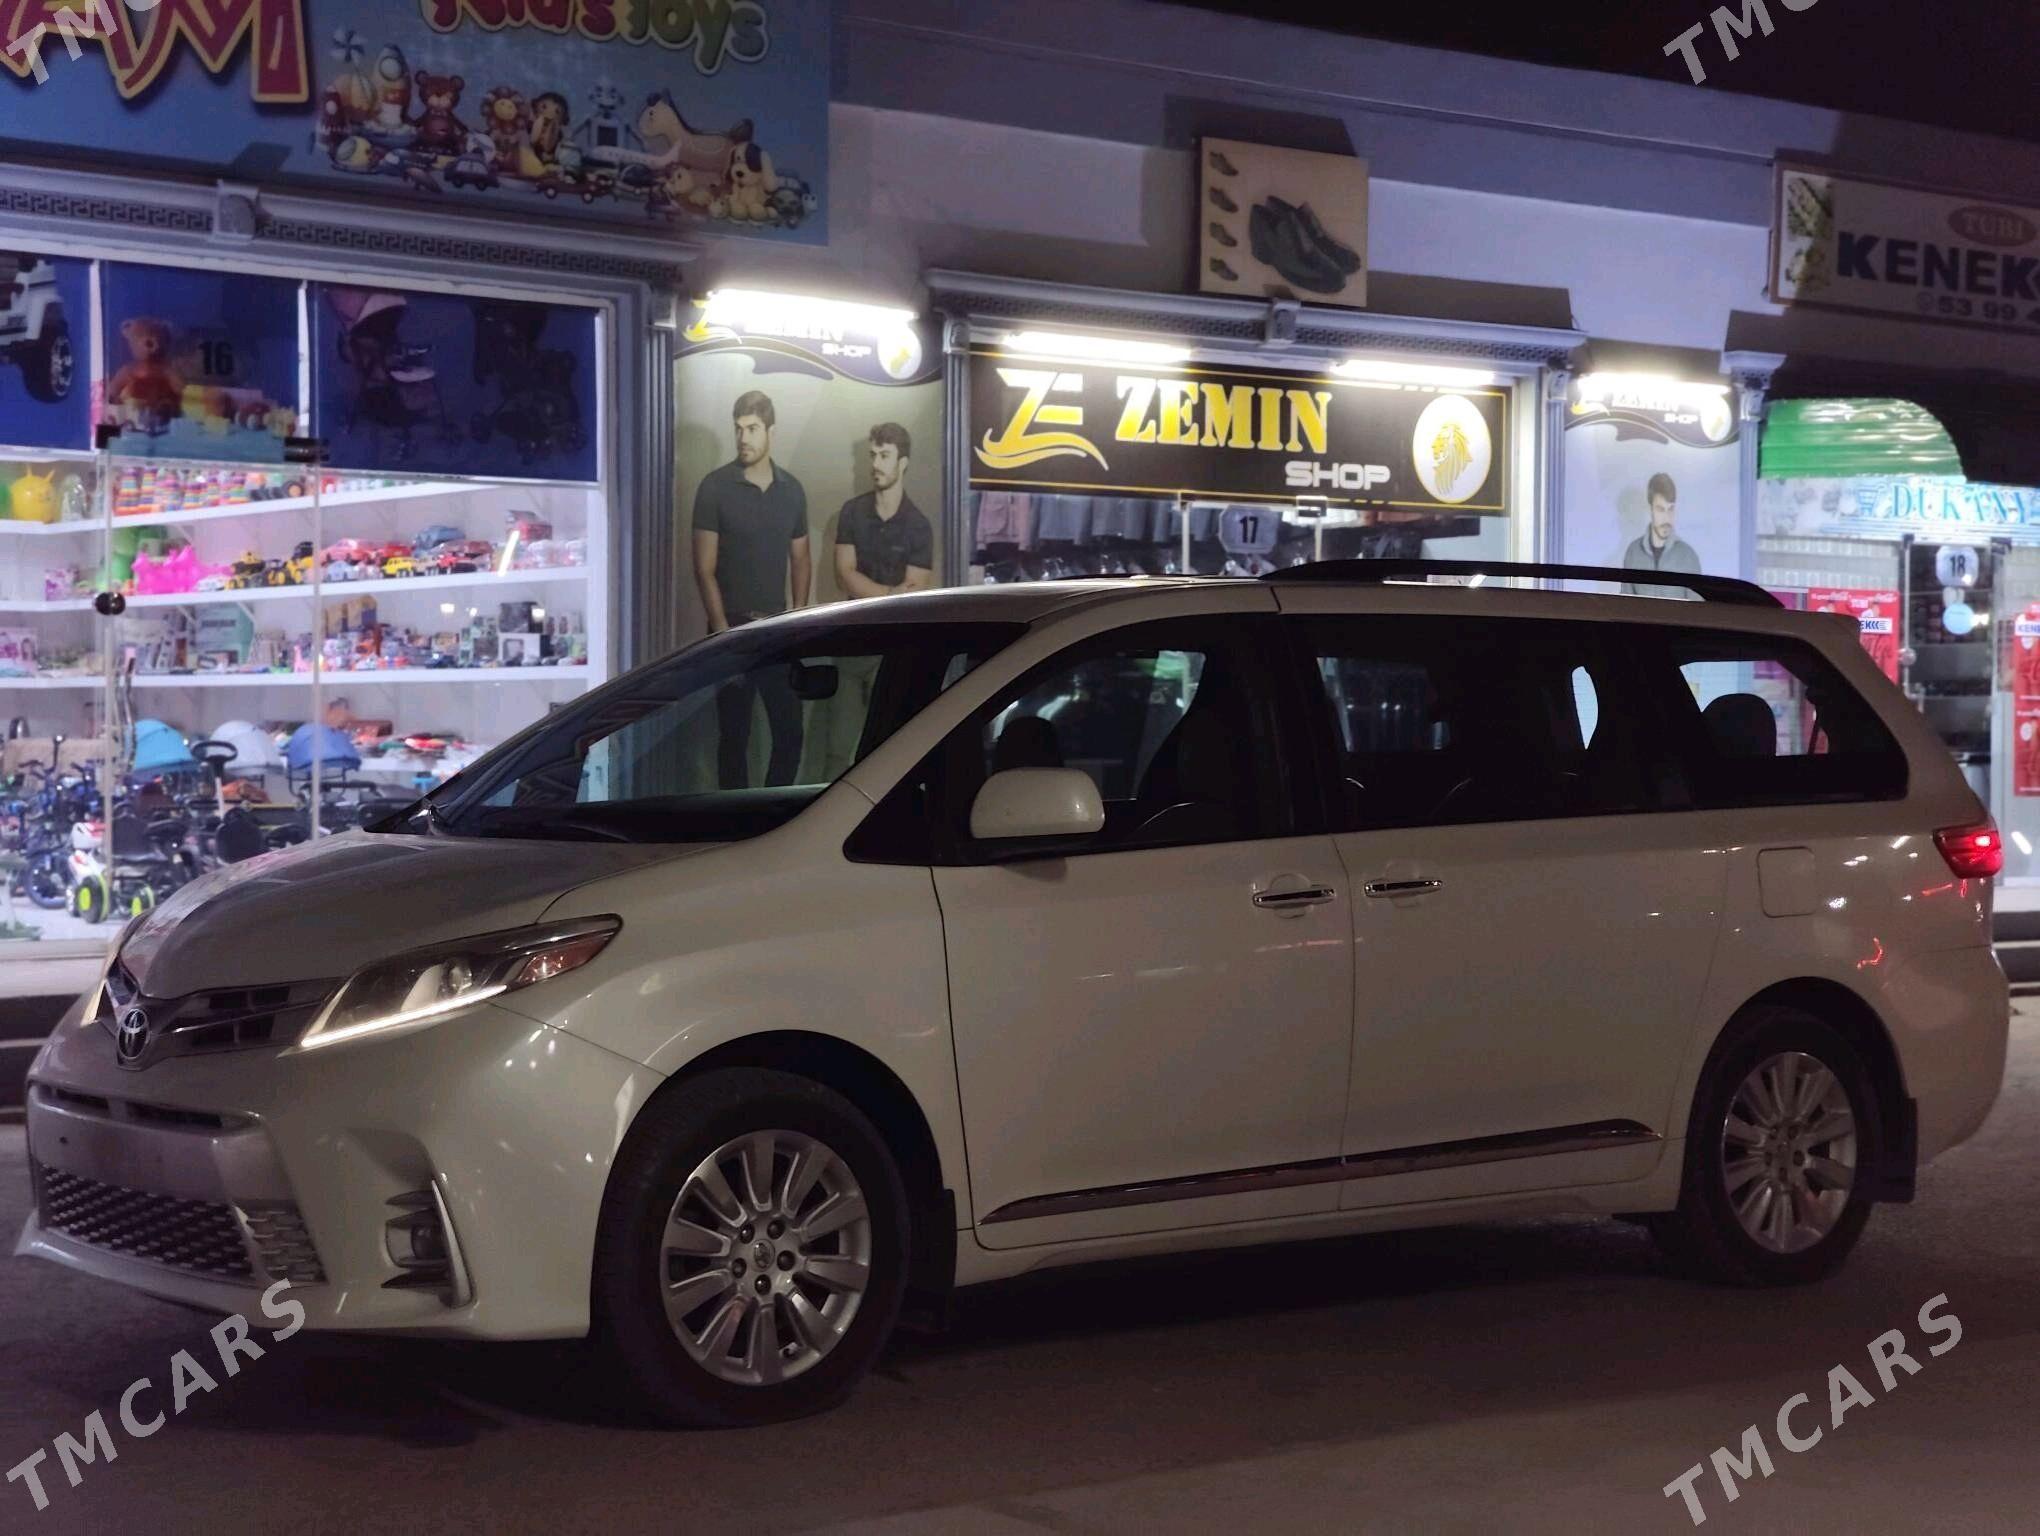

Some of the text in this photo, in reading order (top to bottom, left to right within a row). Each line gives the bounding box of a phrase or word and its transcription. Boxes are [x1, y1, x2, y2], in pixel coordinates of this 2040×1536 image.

[199, 340, 234, 376] 16
[1114, 375, 1333, 455] ZEMIN
[1284, 460, 1391, 491] SHOP
[1239, 515, 1259, 544] 17
[1949, 553, 1967, 576] 18
